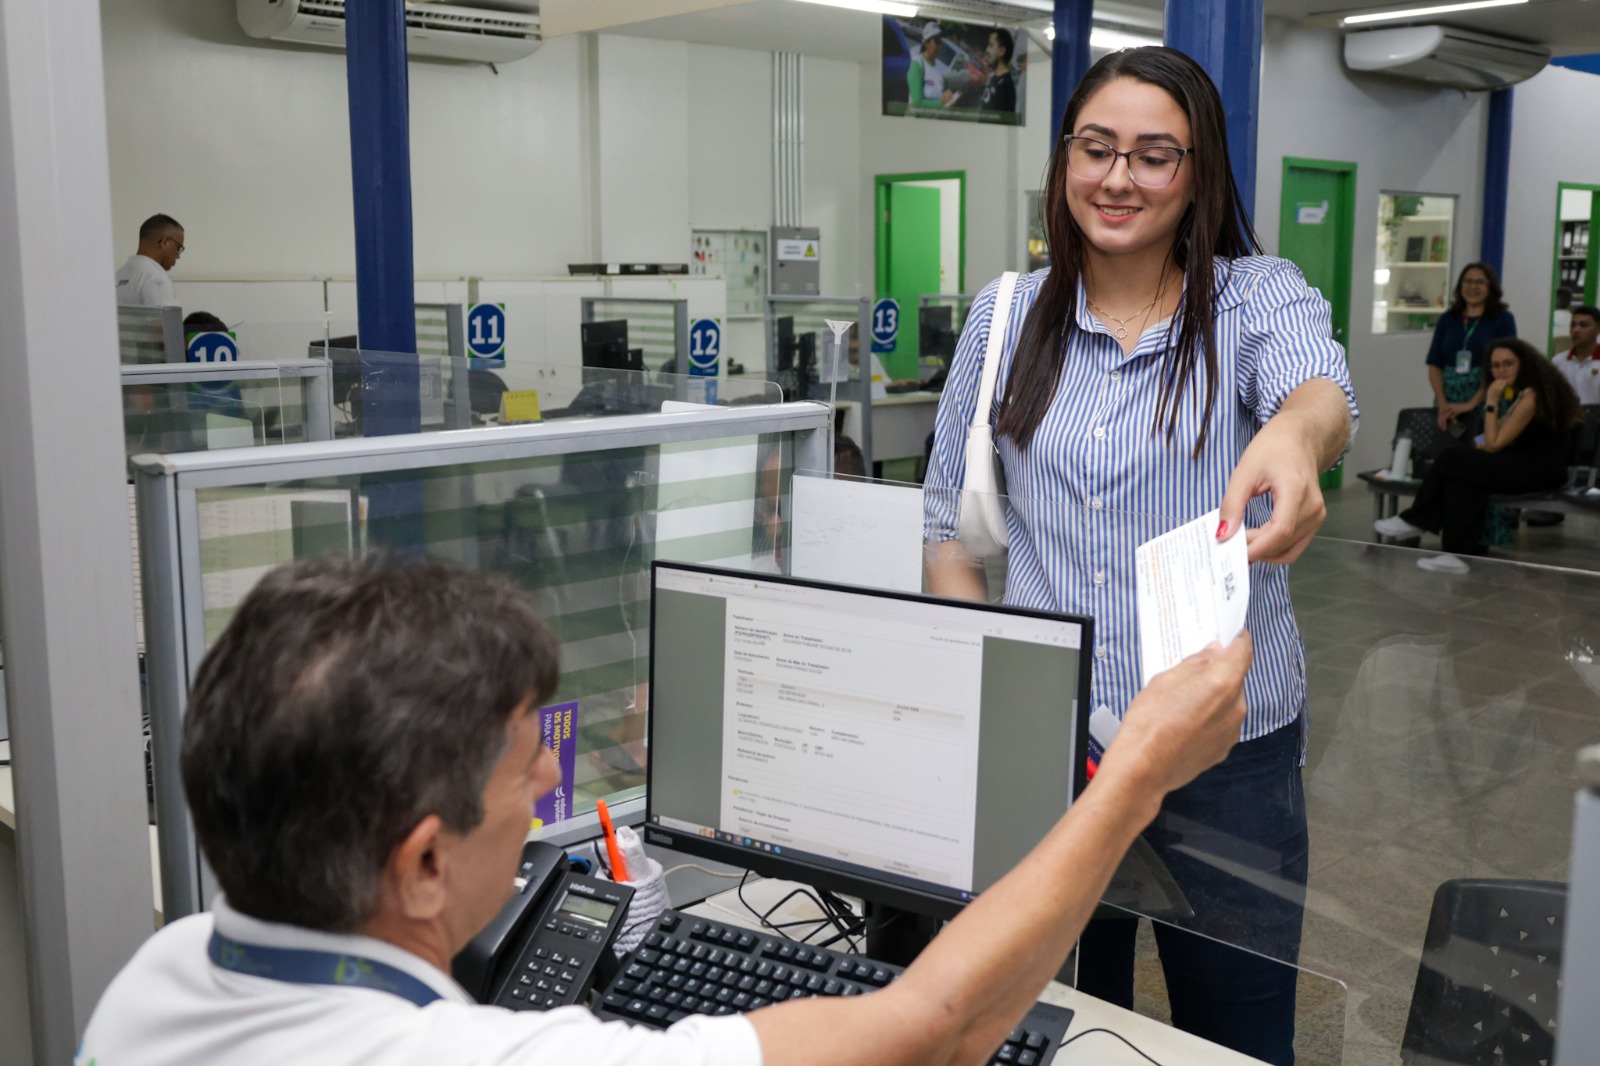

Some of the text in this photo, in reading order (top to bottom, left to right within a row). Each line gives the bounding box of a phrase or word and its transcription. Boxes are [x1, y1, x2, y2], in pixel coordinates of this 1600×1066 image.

[472, 315, 501, 344] 11
[874, 309, 897, 333] 13
[692, 329, 717, 356] 12
[544, 714, 552, 736] PARA
[554, 712, 562, 724] OS
[563, 709, 572, 740] TODOS
